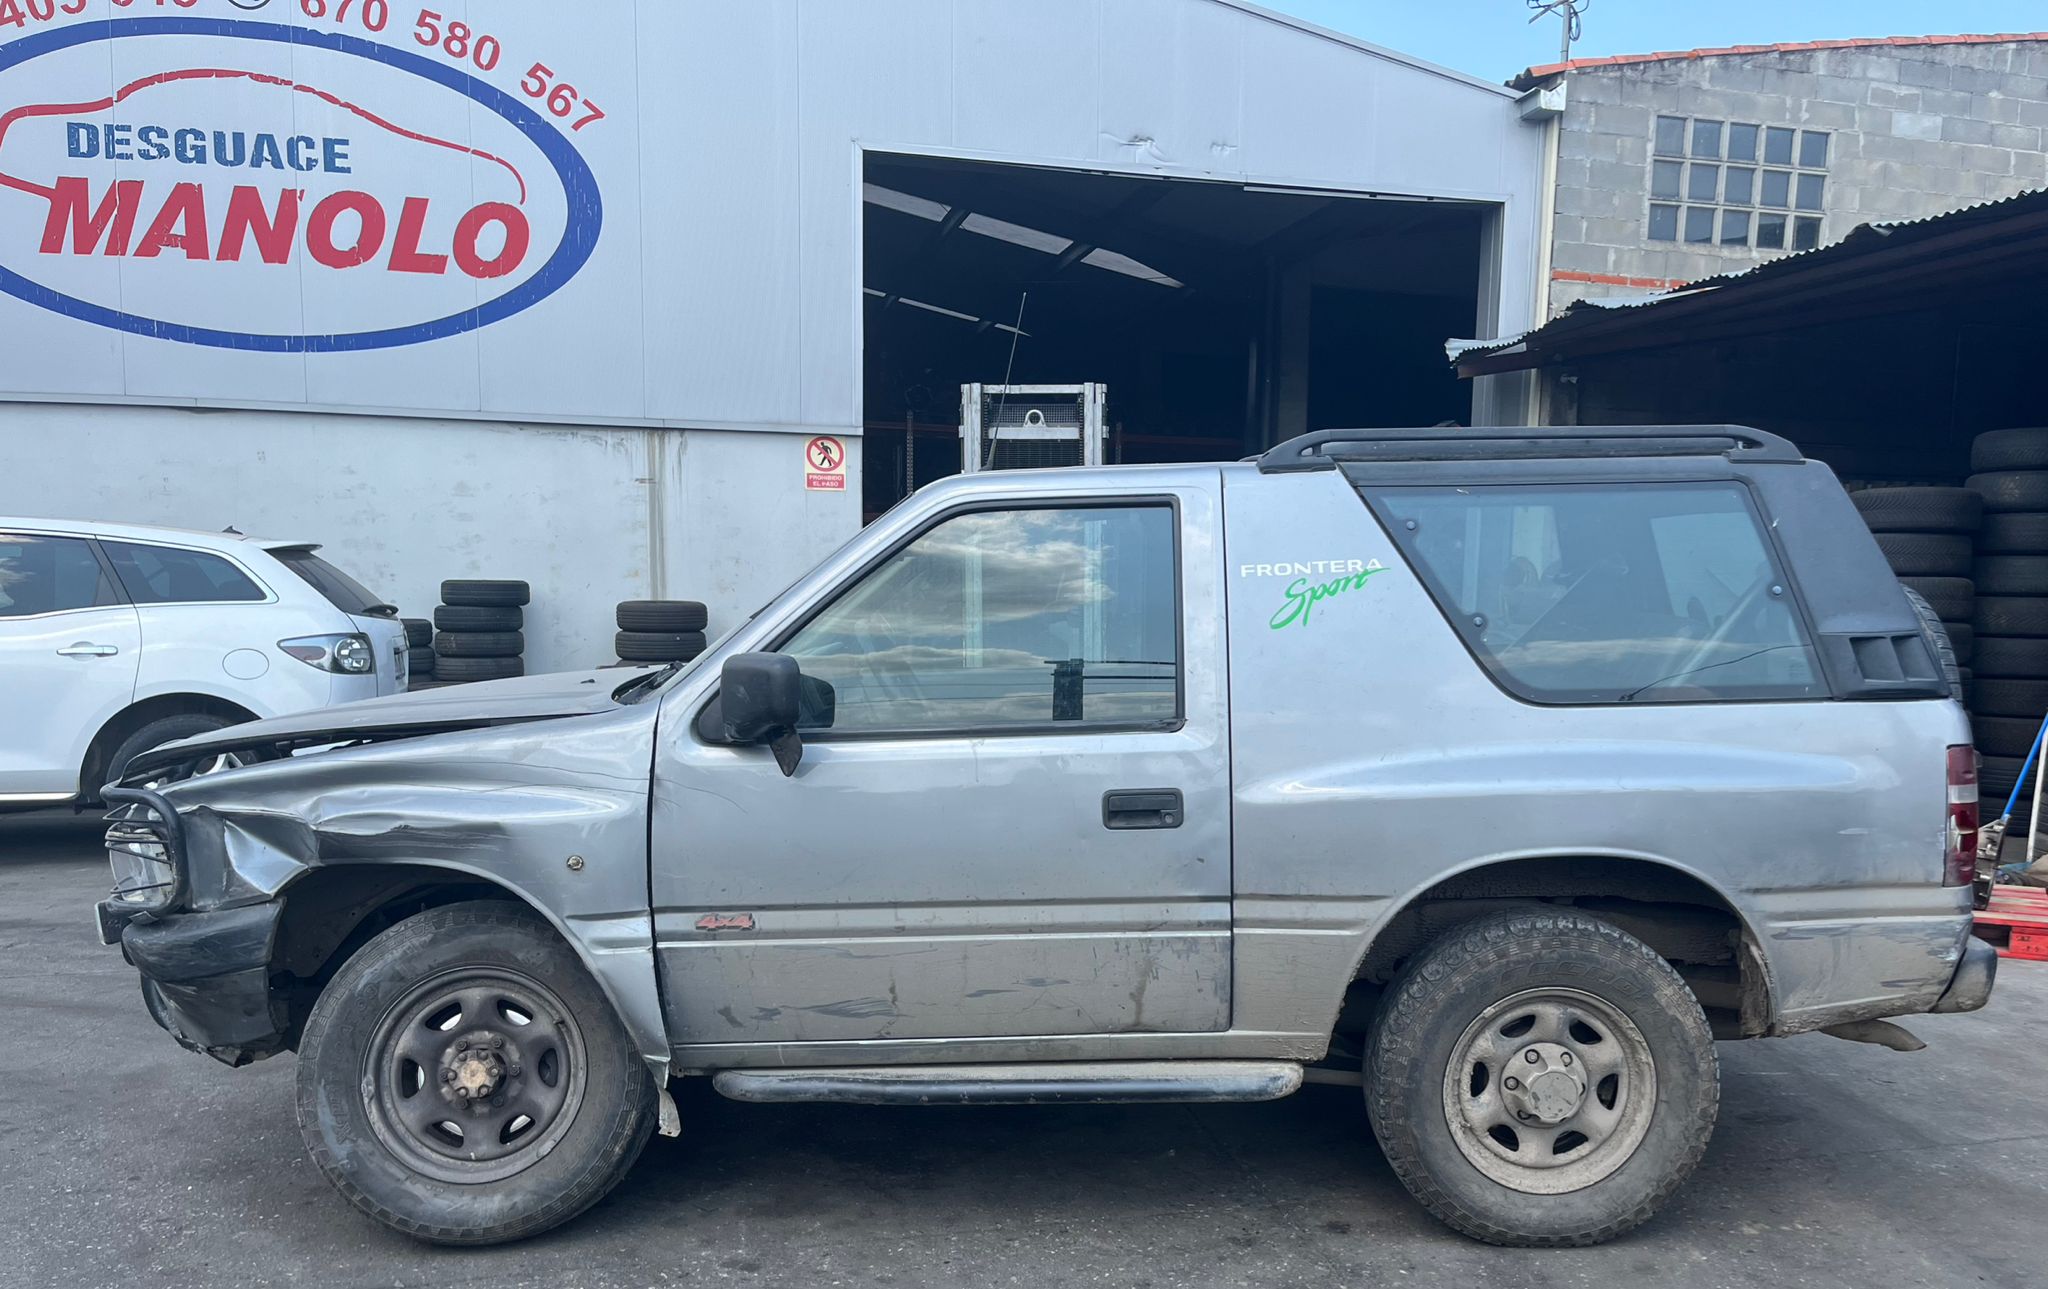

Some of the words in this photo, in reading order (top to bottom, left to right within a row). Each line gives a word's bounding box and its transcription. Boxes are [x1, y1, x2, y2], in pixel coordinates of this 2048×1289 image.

[413, 8, 501, 72] 580
[520, 62, 606, 132] 567
[66, 121, 353, 175] DESGUACE
[38, 175, 530, 279] MANOLO
[1240, 557, 1384, 578] FRONTERA
[1269, 566, 1391, 630] Sport
